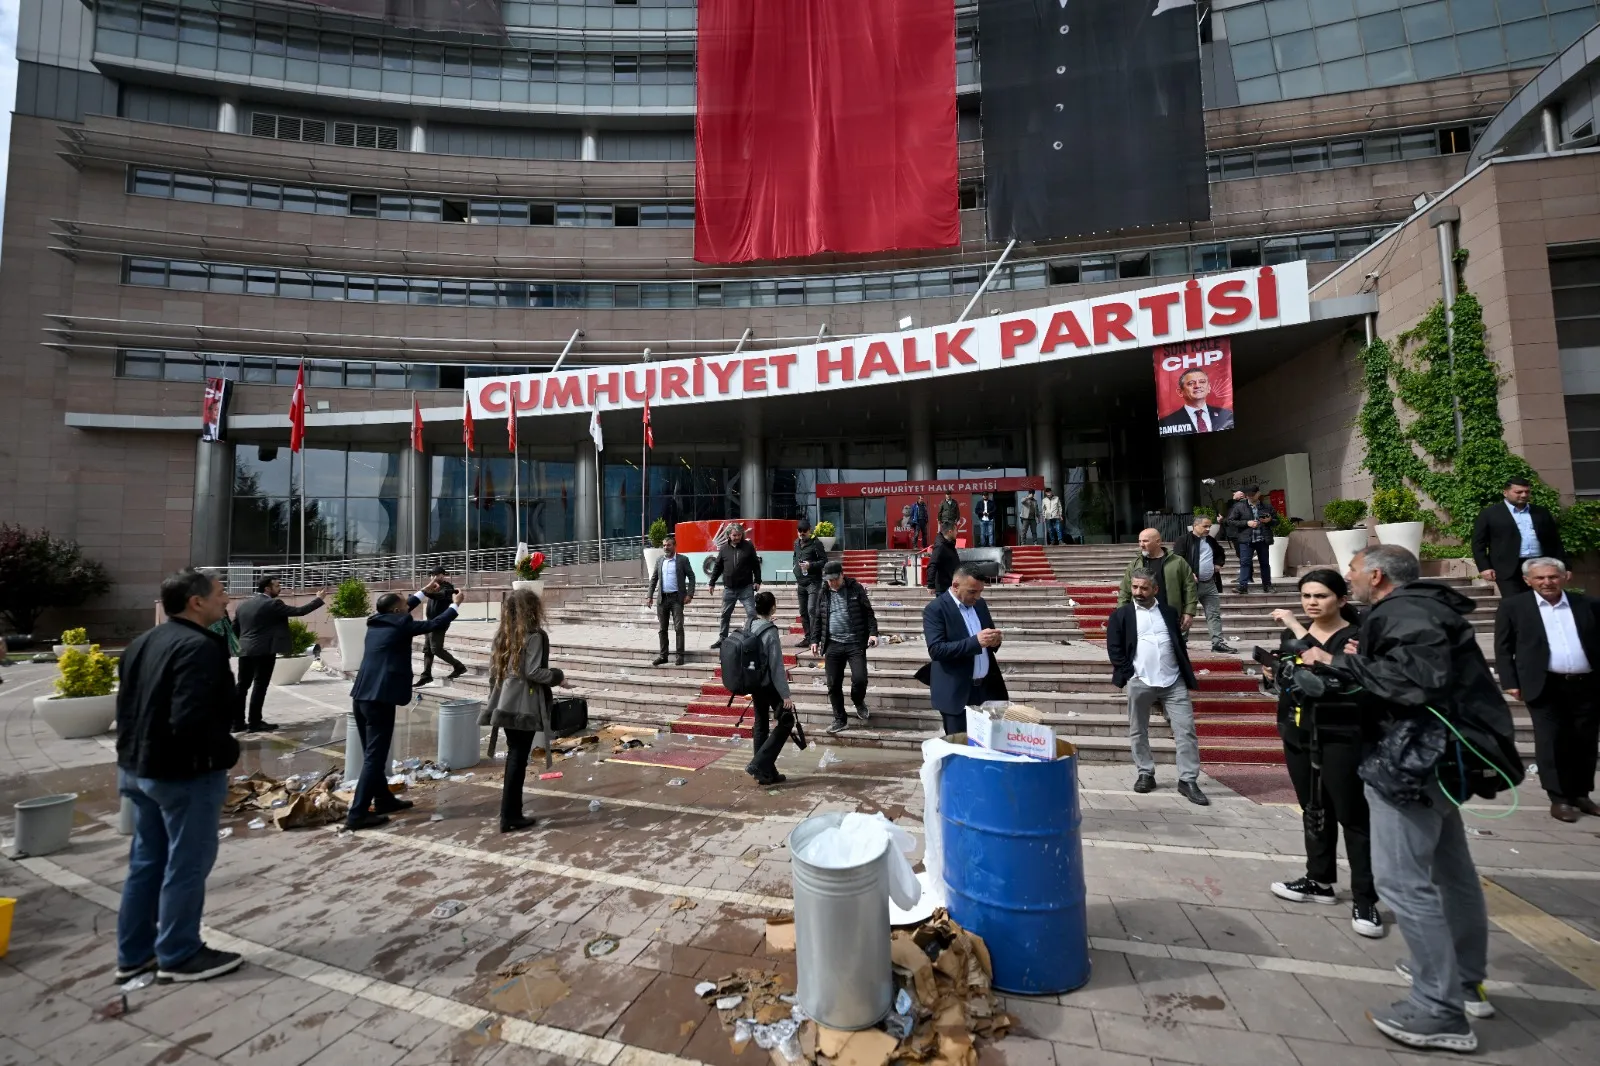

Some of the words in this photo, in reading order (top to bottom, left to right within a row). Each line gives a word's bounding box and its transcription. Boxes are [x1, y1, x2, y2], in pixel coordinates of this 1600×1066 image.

[479, 352, 798, 412] CUMHURİYET
[816, 319, 976, 384] HALK
[999, 264, 1279, 368] PARTİSİ
[1161, 349, 1224, 371] CHP
[860, 482, 925, 494] CUMHURİYET
[928, 483, 955, 492] HALK
[958, 480, 997, 491] PARTİSİ
